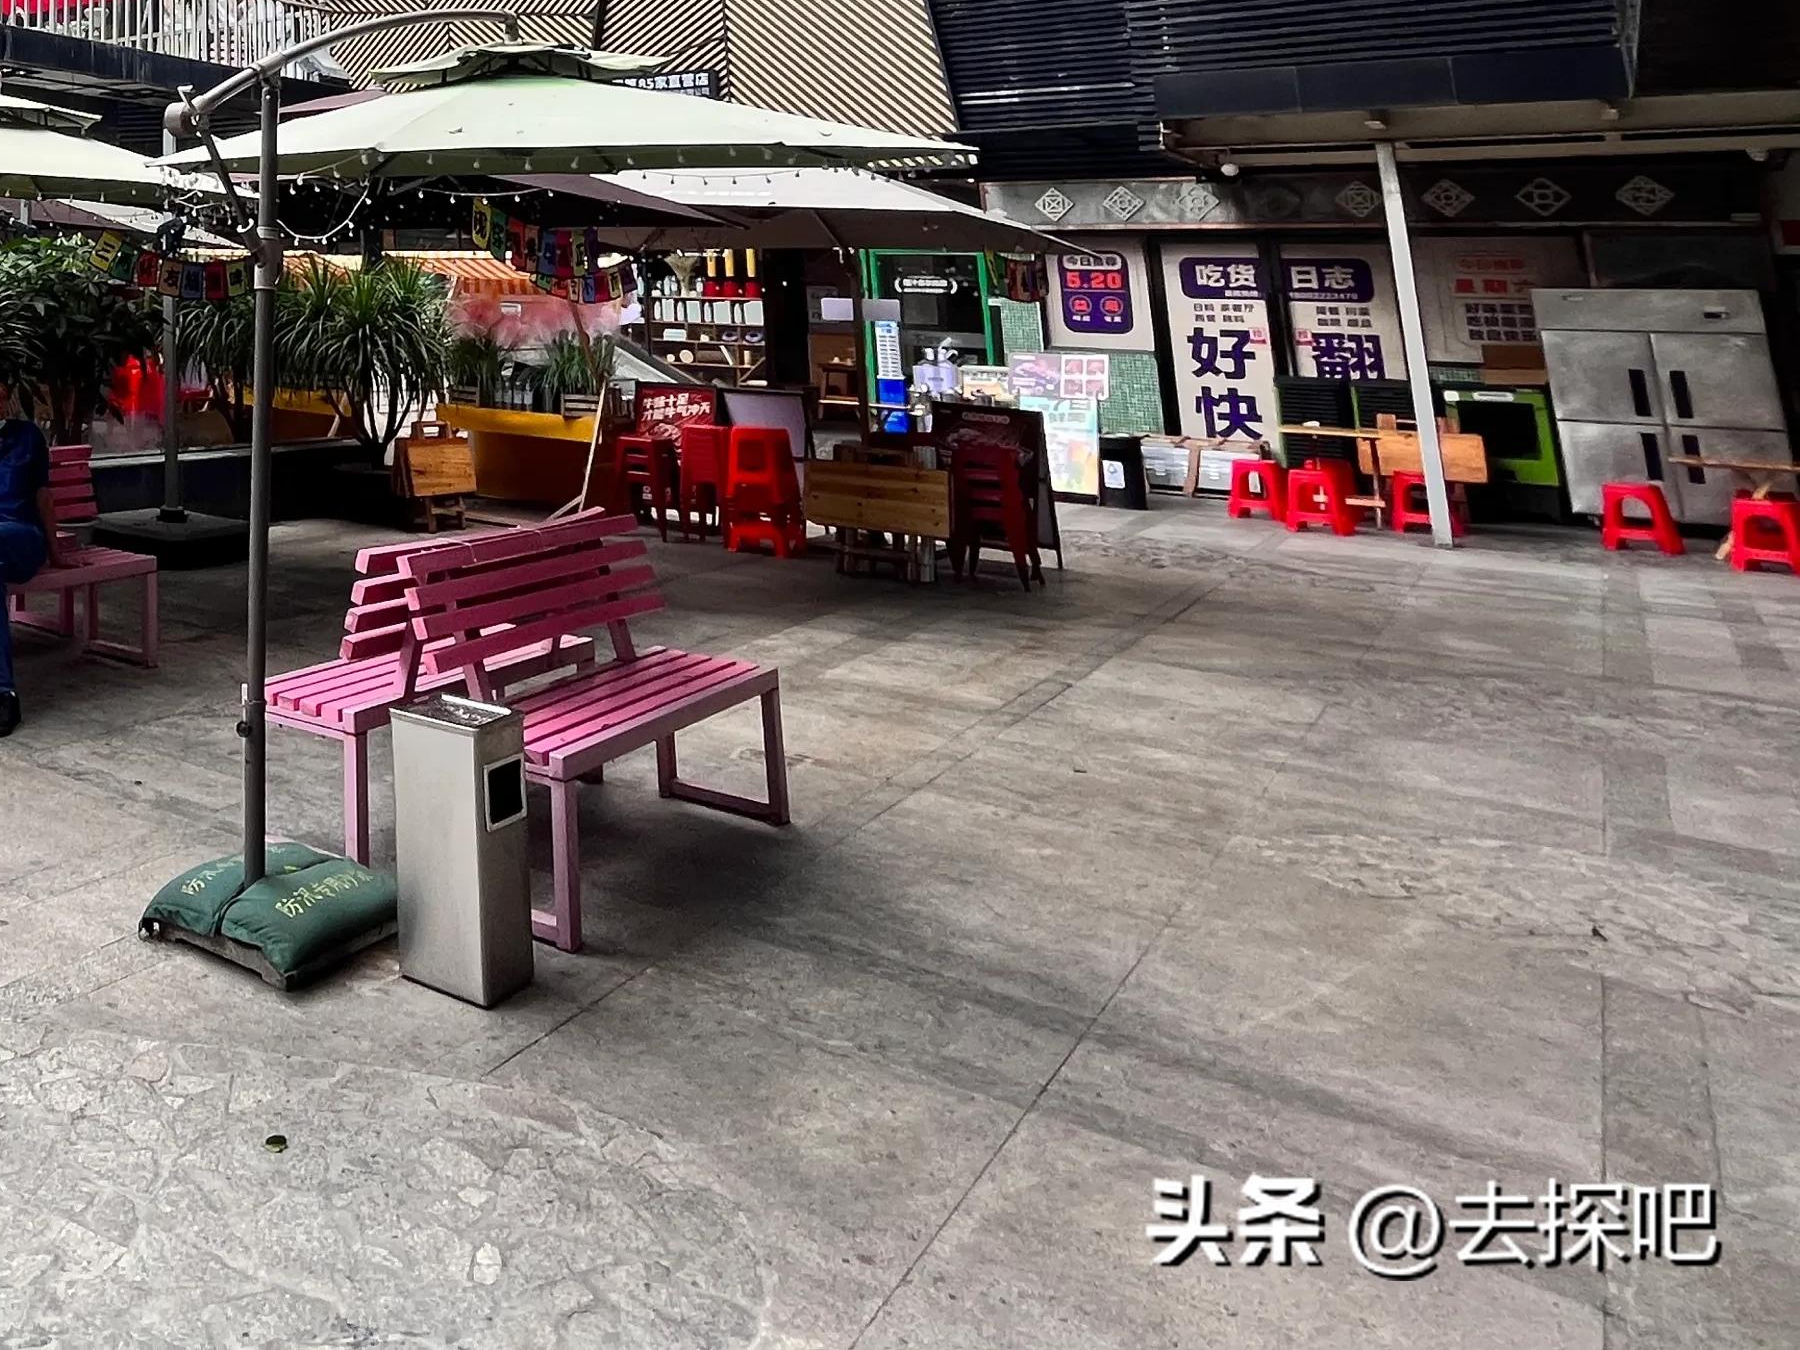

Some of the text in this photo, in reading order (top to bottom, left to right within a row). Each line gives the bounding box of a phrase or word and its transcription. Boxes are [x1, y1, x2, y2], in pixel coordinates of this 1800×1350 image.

[1195, 263, 1355, 290] 吃货 日志
[1312, 333, 1386, 379] 翻
